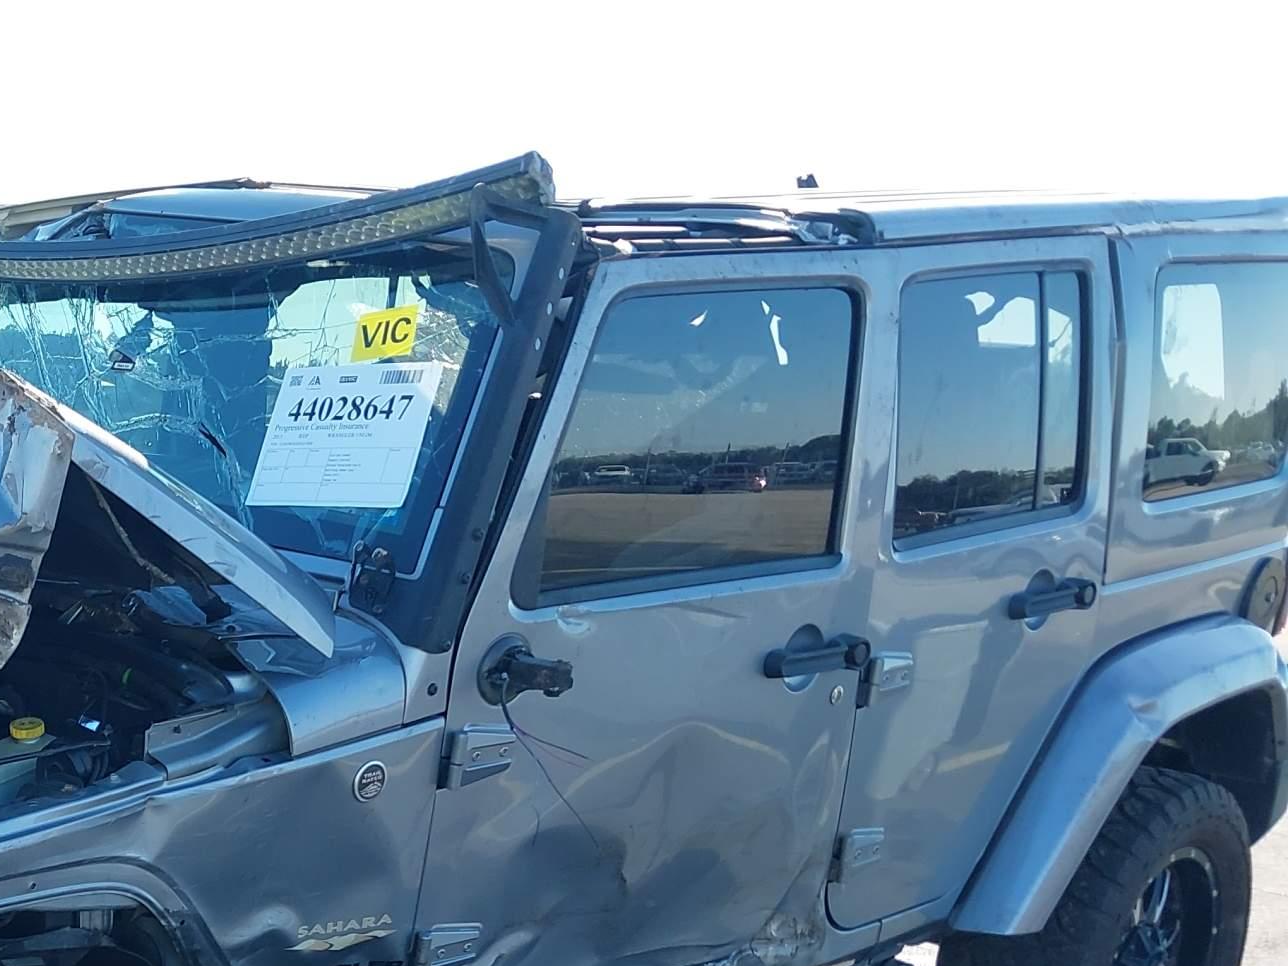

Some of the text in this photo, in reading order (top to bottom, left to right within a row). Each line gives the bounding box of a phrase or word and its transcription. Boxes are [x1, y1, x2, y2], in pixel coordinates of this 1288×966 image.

[361, 317, 412, 349] VIC
[288, 395, 415, 422] 44028647
[274, 423, 369, 433] Progressive Casualty Insurance
[297, 913, 393, 939] SAHARA
